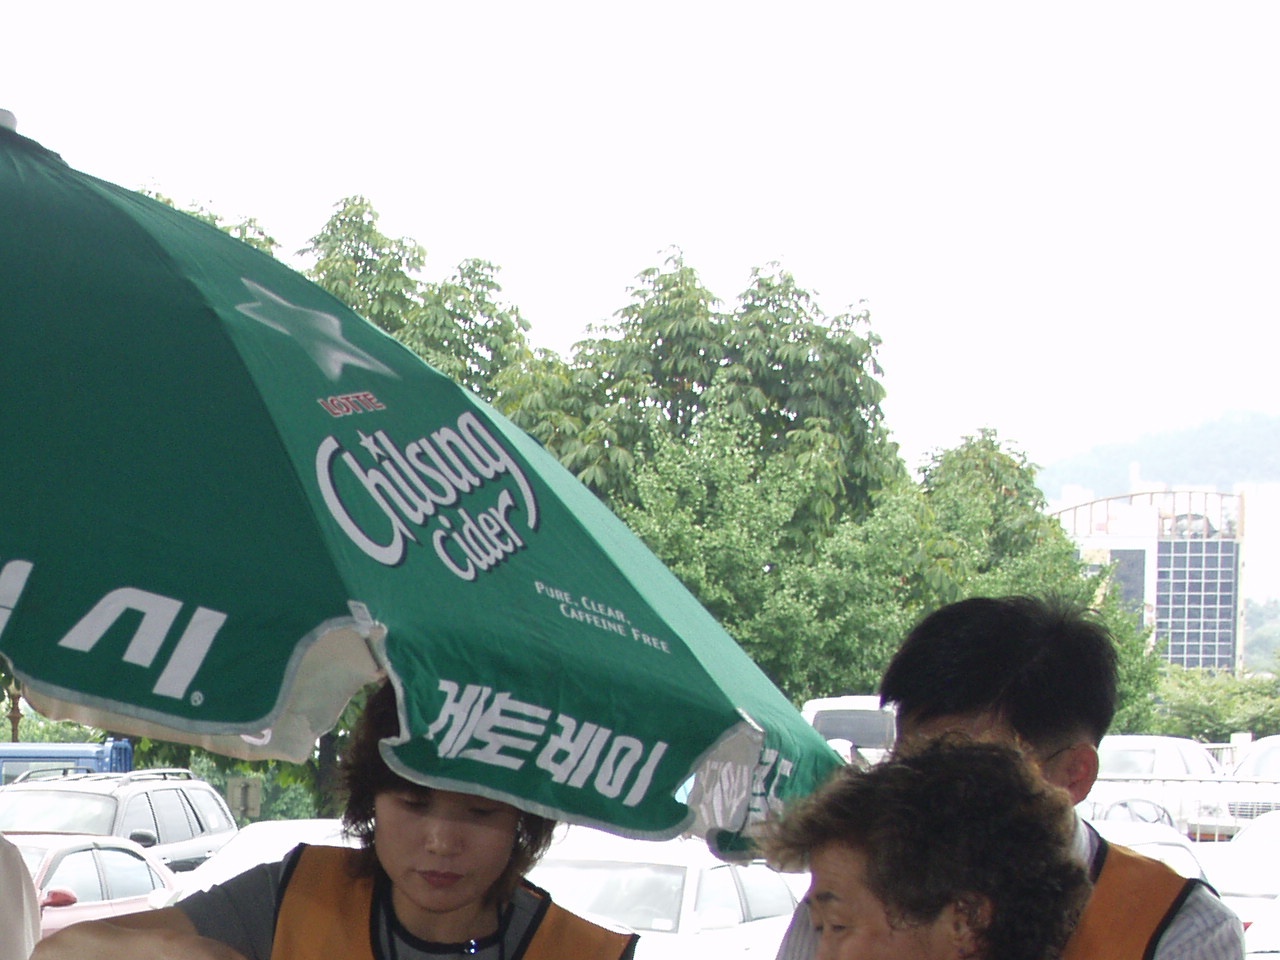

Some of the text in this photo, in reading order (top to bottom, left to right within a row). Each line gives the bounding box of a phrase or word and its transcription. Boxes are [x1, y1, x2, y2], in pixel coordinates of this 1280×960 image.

[317, 391, 386, 418] LOTTE
[315, 411, 539, 567] Chilsung
[559, 603, 671, 655] CAFFEINE FREE
[428, 679, 668, 806] 게토레이
